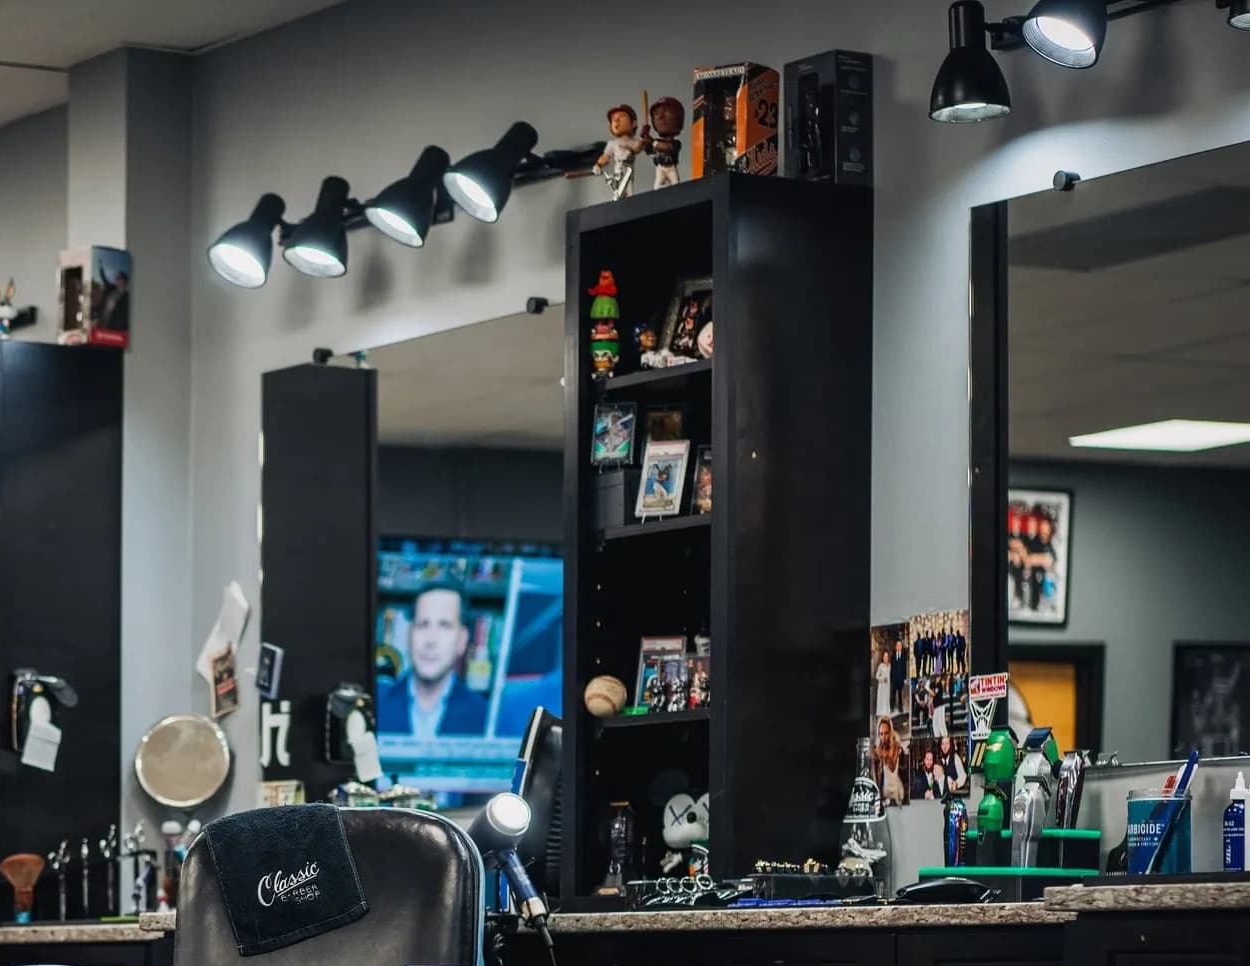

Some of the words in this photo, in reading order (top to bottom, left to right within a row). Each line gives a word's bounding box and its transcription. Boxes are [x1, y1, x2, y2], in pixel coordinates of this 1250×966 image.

[981, 675, 1007, 687] TINTIN'
[1127, 823, 1162, 835] ARBICIDE
[258, 861, 320, 907] Classic
[280, 884, 318, 902] BRBER
